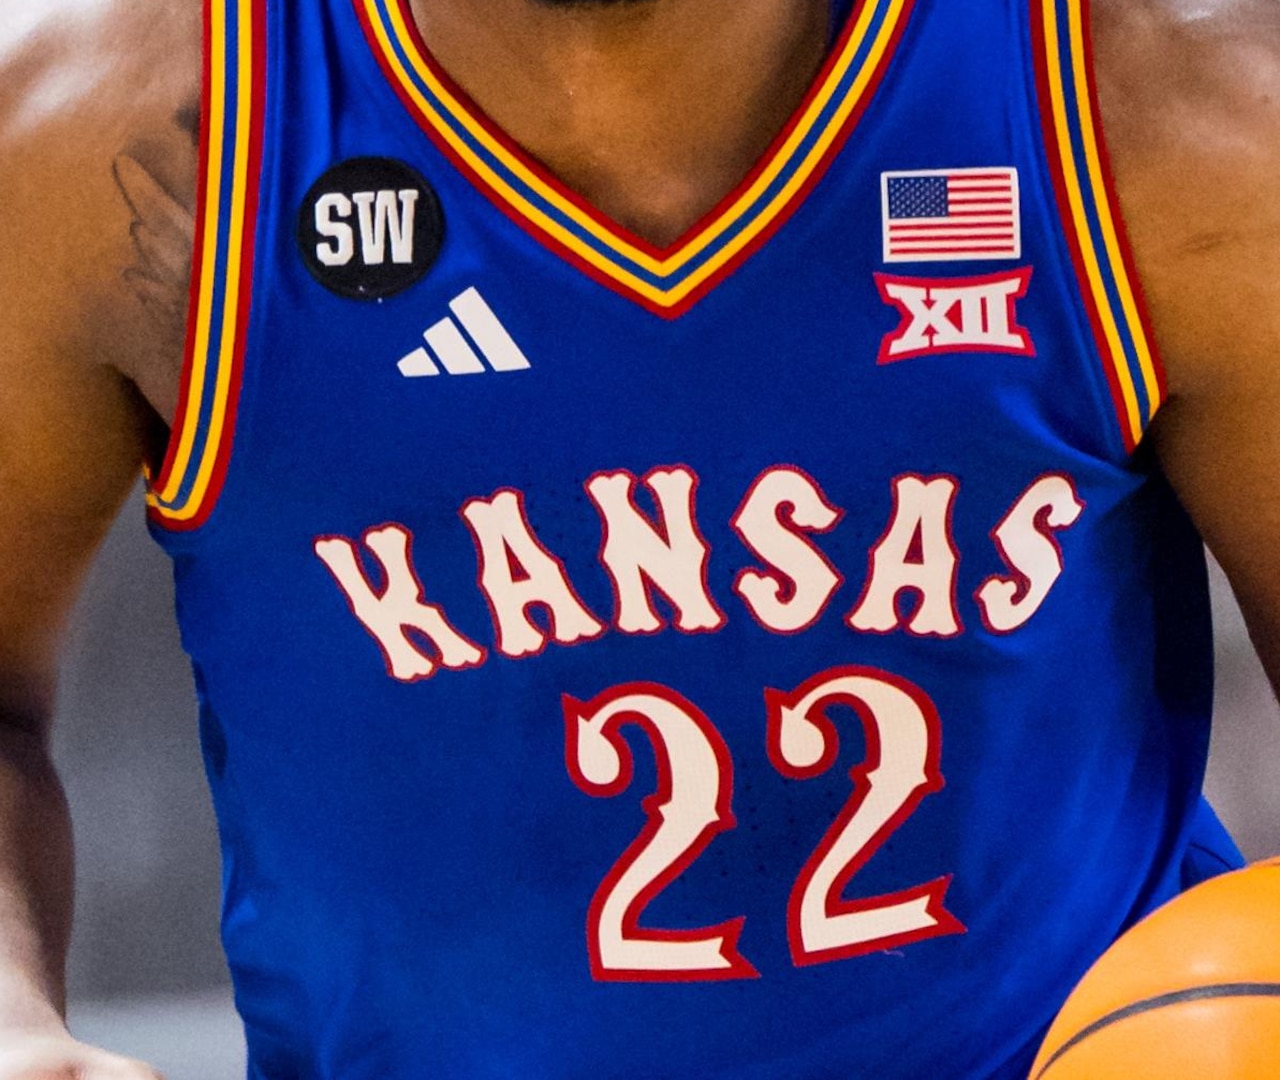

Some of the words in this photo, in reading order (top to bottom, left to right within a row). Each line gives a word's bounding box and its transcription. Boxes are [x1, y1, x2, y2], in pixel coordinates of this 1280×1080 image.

[314, 189, 419, 266] SW
[884, 276, 1027, 357] XII
[314, 464, 1086, 682] KANSAS
[561, 664, 966, 981] 22
